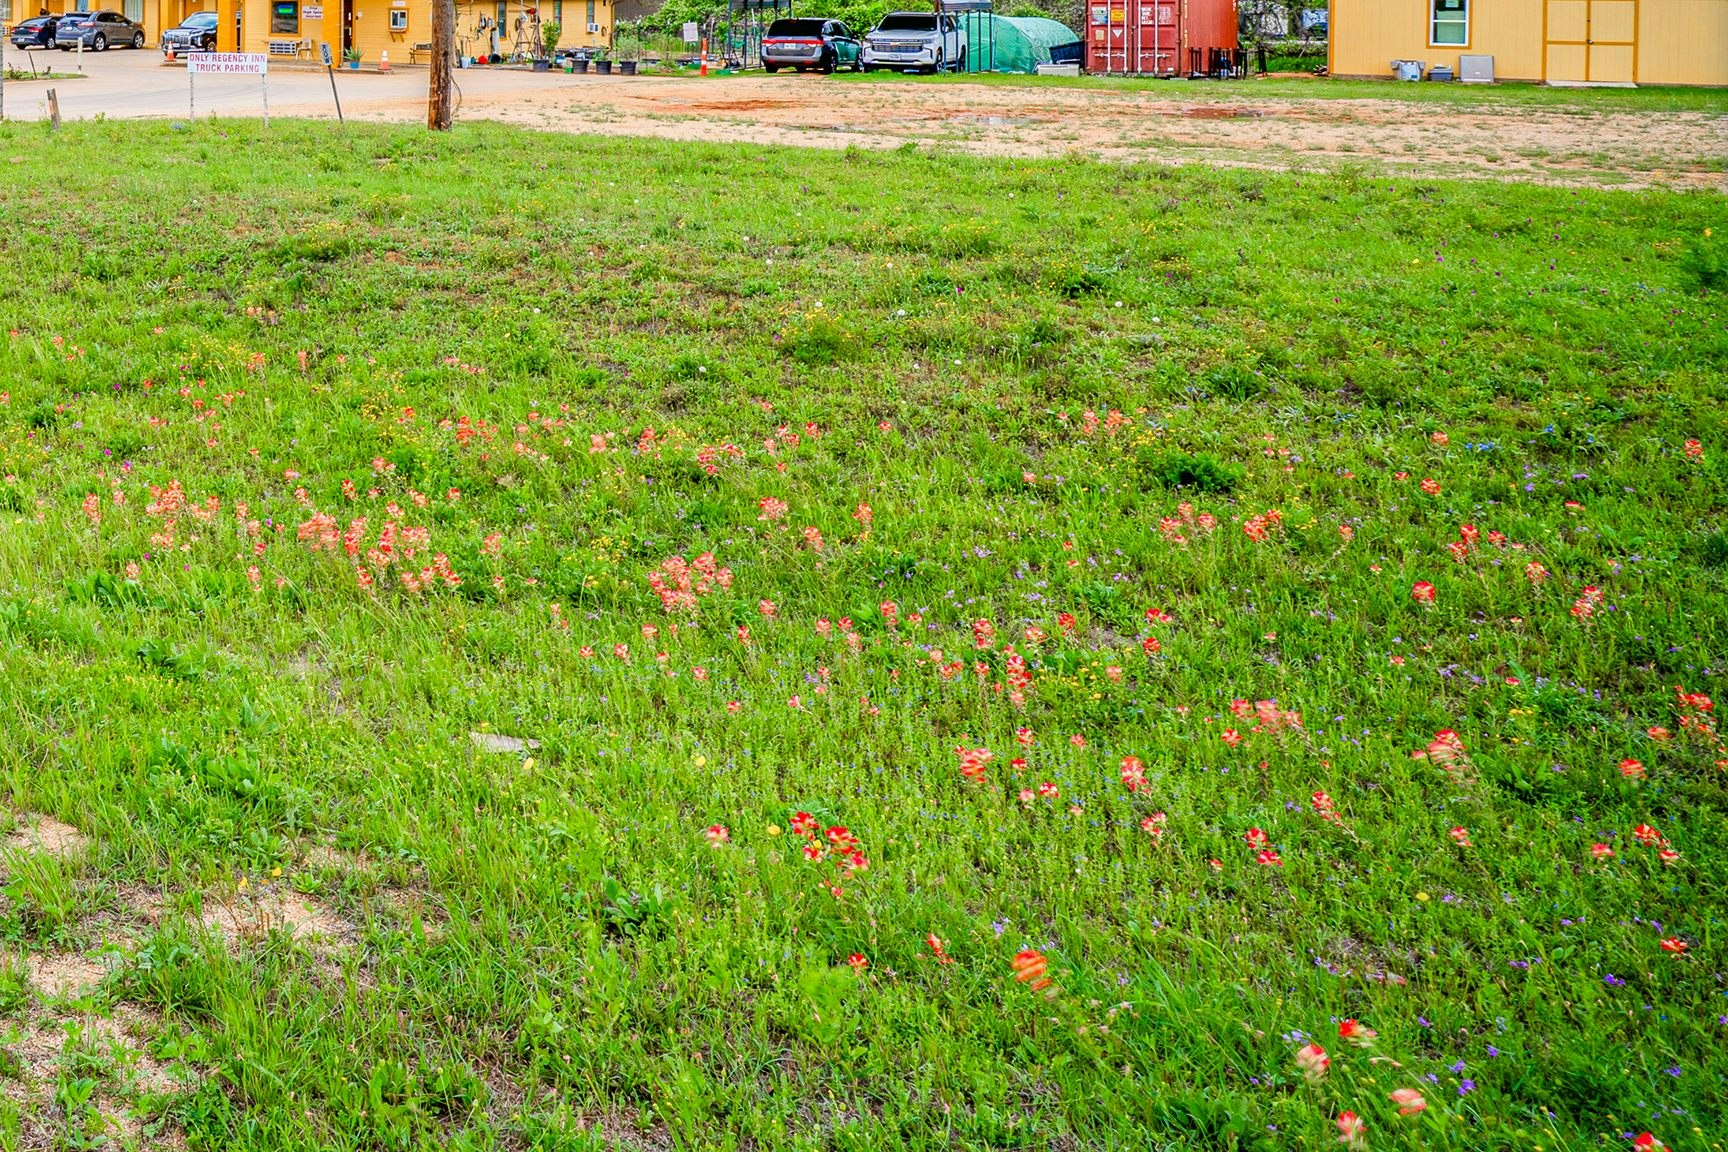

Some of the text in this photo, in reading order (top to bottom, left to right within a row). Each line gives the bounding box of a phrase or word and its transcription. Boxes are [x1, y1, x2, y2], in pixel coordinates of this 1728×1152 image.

[189, 53, 266, 62] ONLY REGENCY INN
[195, 63, 260, 73] TRUCK PARKING
